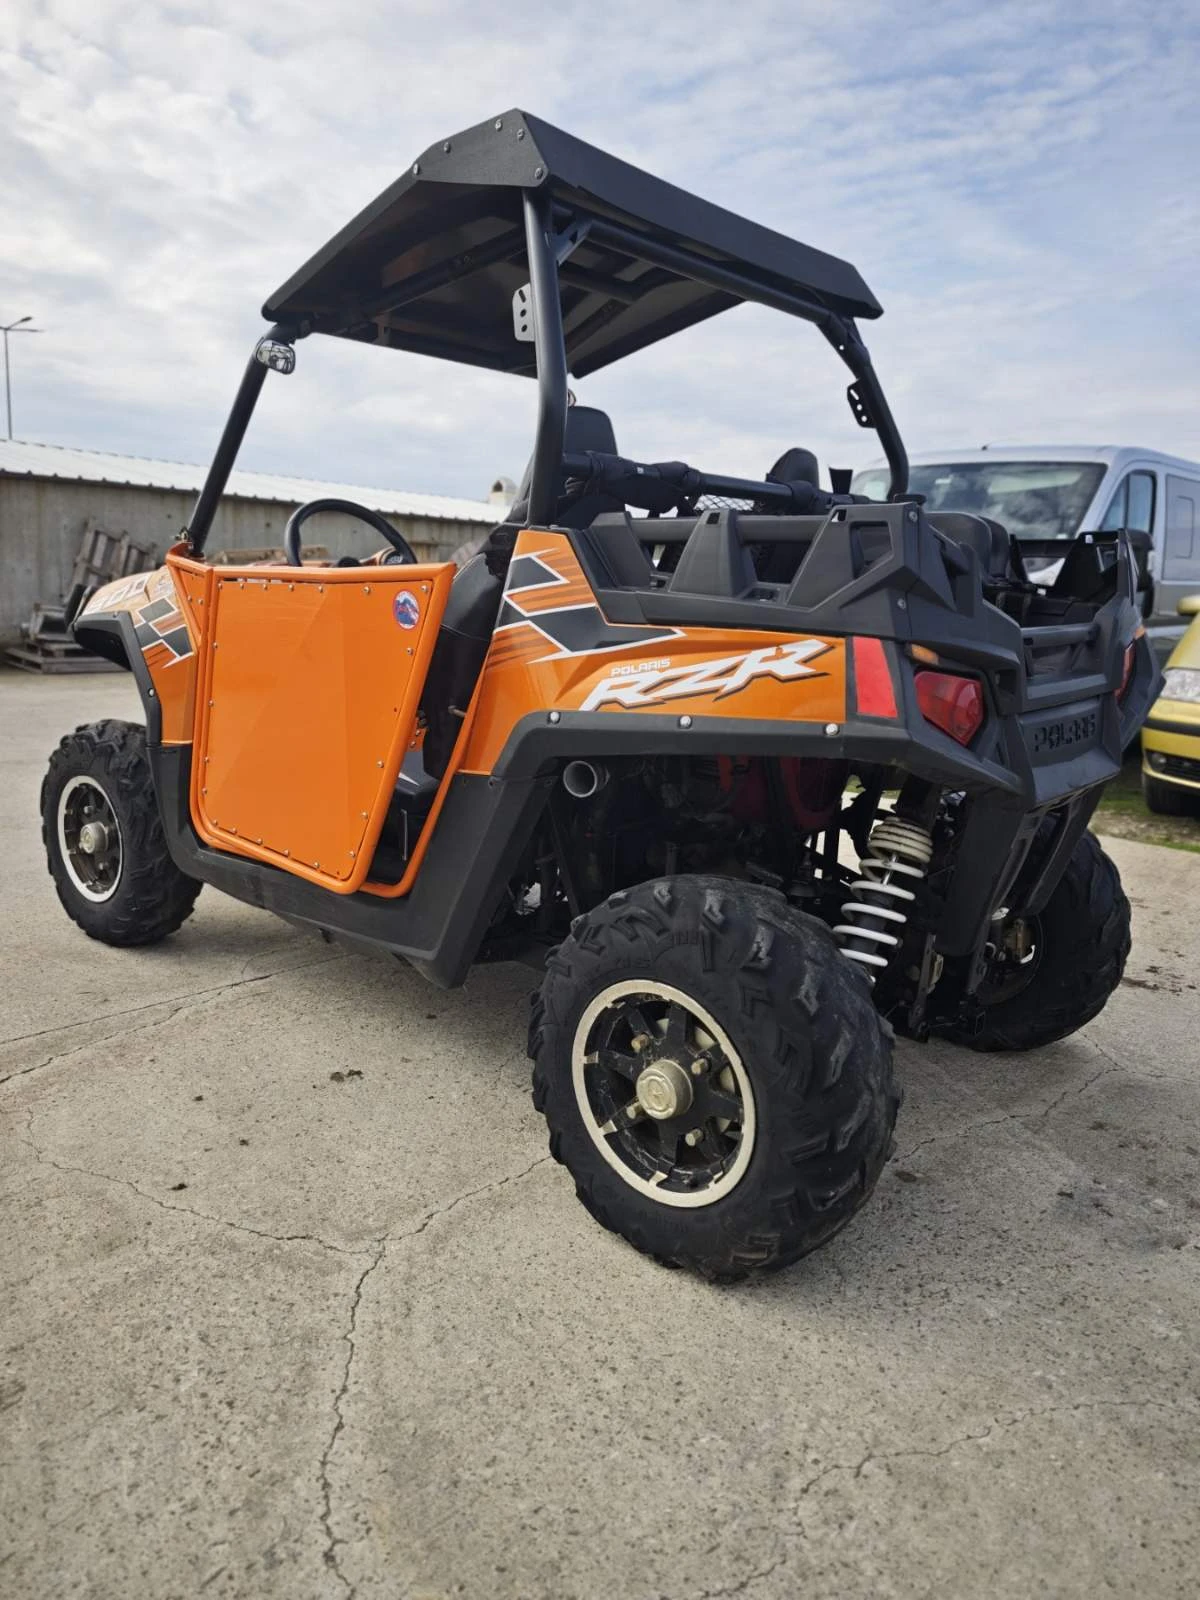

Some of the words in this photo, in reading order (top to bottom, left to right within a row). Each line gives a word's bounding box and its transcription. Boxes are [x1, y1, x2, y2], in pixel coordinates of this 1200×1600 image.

[578, 638, 829, 711] RZR
[611, 658, 671, 677] POLARIS
[1033, 713, 1096, 753] POLARIS
